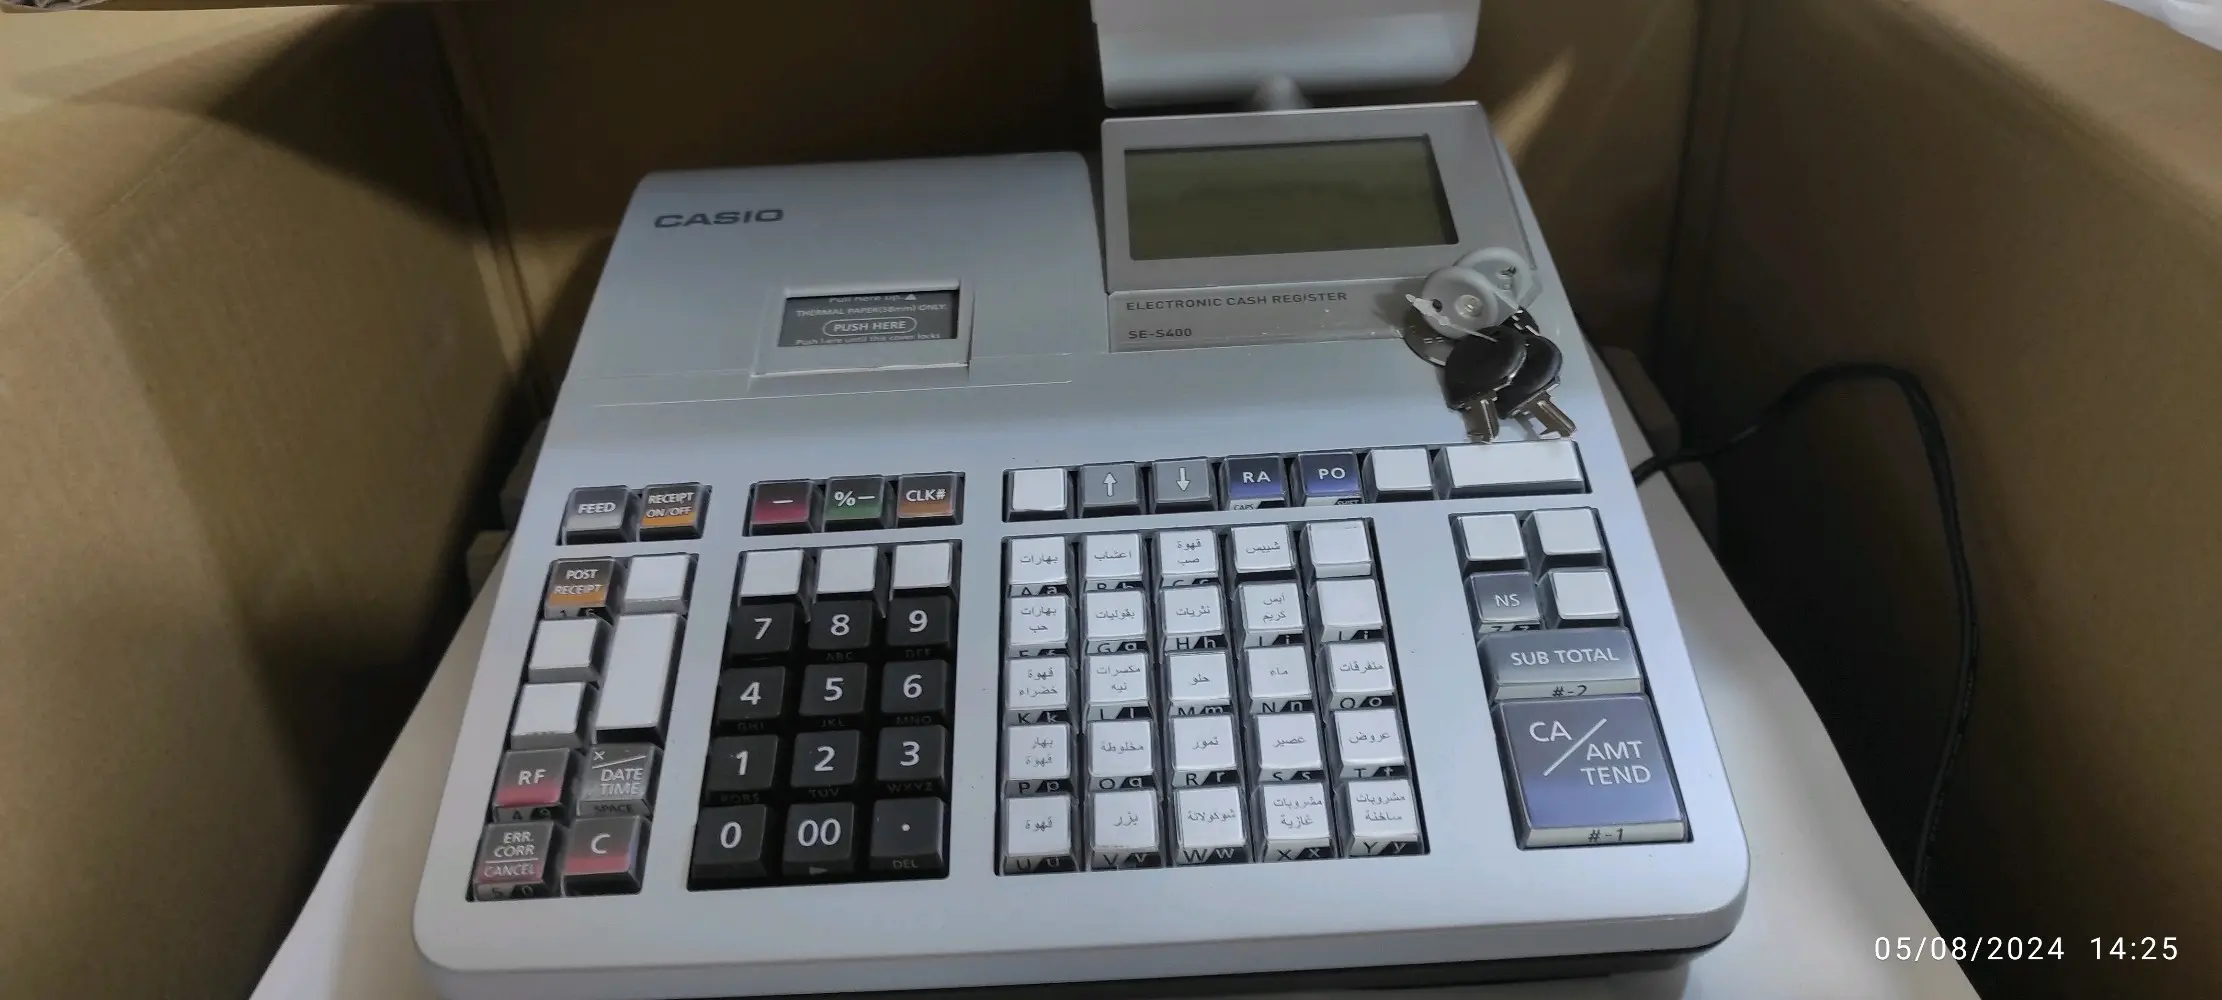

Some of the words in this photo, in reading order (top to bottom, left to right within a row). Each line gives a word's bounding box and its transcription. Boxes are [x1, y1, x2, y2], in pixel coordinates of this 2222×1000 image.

[653, 209, 785, 228] CASIO
[1126, 298, 1222, 311] ELECTRONIC
[1227, 296, 1267, 306] CASH
[1273, 292, 1348, 305] REGISTER
[796, 308, 844, 317] THERMAL
[833, 323, 869, 333] PUSH
[872, 321, 907, 331] HERE
[1128, 328, 1192, 339] SE-S400
[917, 332, 940, 340] locks
[1242, 471, 1271, 484] RA
[1318, 467, 1346, 480] PO
[648, 492, 695, 504] RECEIPT
[906, 489, 946, 502] CLK#
[578, 502, 616, 514] FEED
[646, 506, 692, 518] ON/OFF
[1177, 538, 1201, 551] قهوة
[1020, 552, 1058, 565] بهارات
[566, 569, 599, 579] POST
[554, 584, 603, 595] RECEIPT
[1494, 593, 1520, 607] NS
[1020, 605, 1057, 617] بهارات
[1096, 608, 1135, 621] بقوليات
[1263, 611, 1287, 624] كريم
[830, 614, 850, 635] 8
[908, 610, 928, 632] 9
[754, 617, 772, 640] 7
[1176, 637, 1190, 650] H
[1204, 637, 1216, 648] h
[1510, 650, 1550, 666] SUB
[1554, 647, 1619, 664] TOTAL
[1028, 667, 1054, 680] قهوة
[1097, 665, 1141, 676] مكسرات
[1270, 667, 1288, 676] ماء
[903, 674, 923, 698] 6
[1191, 673, 1210, 686] حلو
[740, 682, 761, 705] 4
[824, 677, 844, 701] 5
[1019, 686, 1058, 698] خضراء
[1262, 702, 1275, 713] N
[1018, 712, 1031, 724] K
[1349, 731, 1391, 744] عروض
[1529, 721, 1572, 743] CA
[1192, 737, 1219, 750] تمور
[1272, 736, 1306, 748] عصير
[900, 741, 920, 766] 3
[1586, 740, 1643, 761] AMT
[734, 751, 749, 776] 1
[814, 746, 836, 772] 2
[1025, 754, 1053, 767] قهوة
[518, 768, 547, 785] RF
[600, 768, 644, 782] DATE
[1186, 773, 1199, 786] R
[1215, 772, 1227, 783] r
[1354, 768, 1367, 778] T
[1580, 766, 1651, 786] TEND
[600, 783, 643, 796] TIME
[1019, 782, 1031, 794] P
[1273, 796, 1323, 809] مشروبات
[1356, 791, 1406, 804] مشروبات
[594, 804, 634, 813] SPACE
[1025, 816, 1053, 832] قهوة
[1281, 815, 1314, 829] غازية
[720, 821, 742, 849] 0
[798, 818, 842, 846] 00
[1588, 828, 1624, 841] #-1
[590, 833, 611, 854] C
[1363, 841, 1378, 853] Y
[494, 844, 536, 858] CORR
[1184, 849, 1207, 862] W
[1217, 848, 1234, 859] w
[1278, 850, 1292, 861] X
[892, 859, 919, 869] DEL
[1017, 859, 1031, 871] U
[1103, 853, 1119, 866] V
[483, 864, 536, 878] CANCEL
